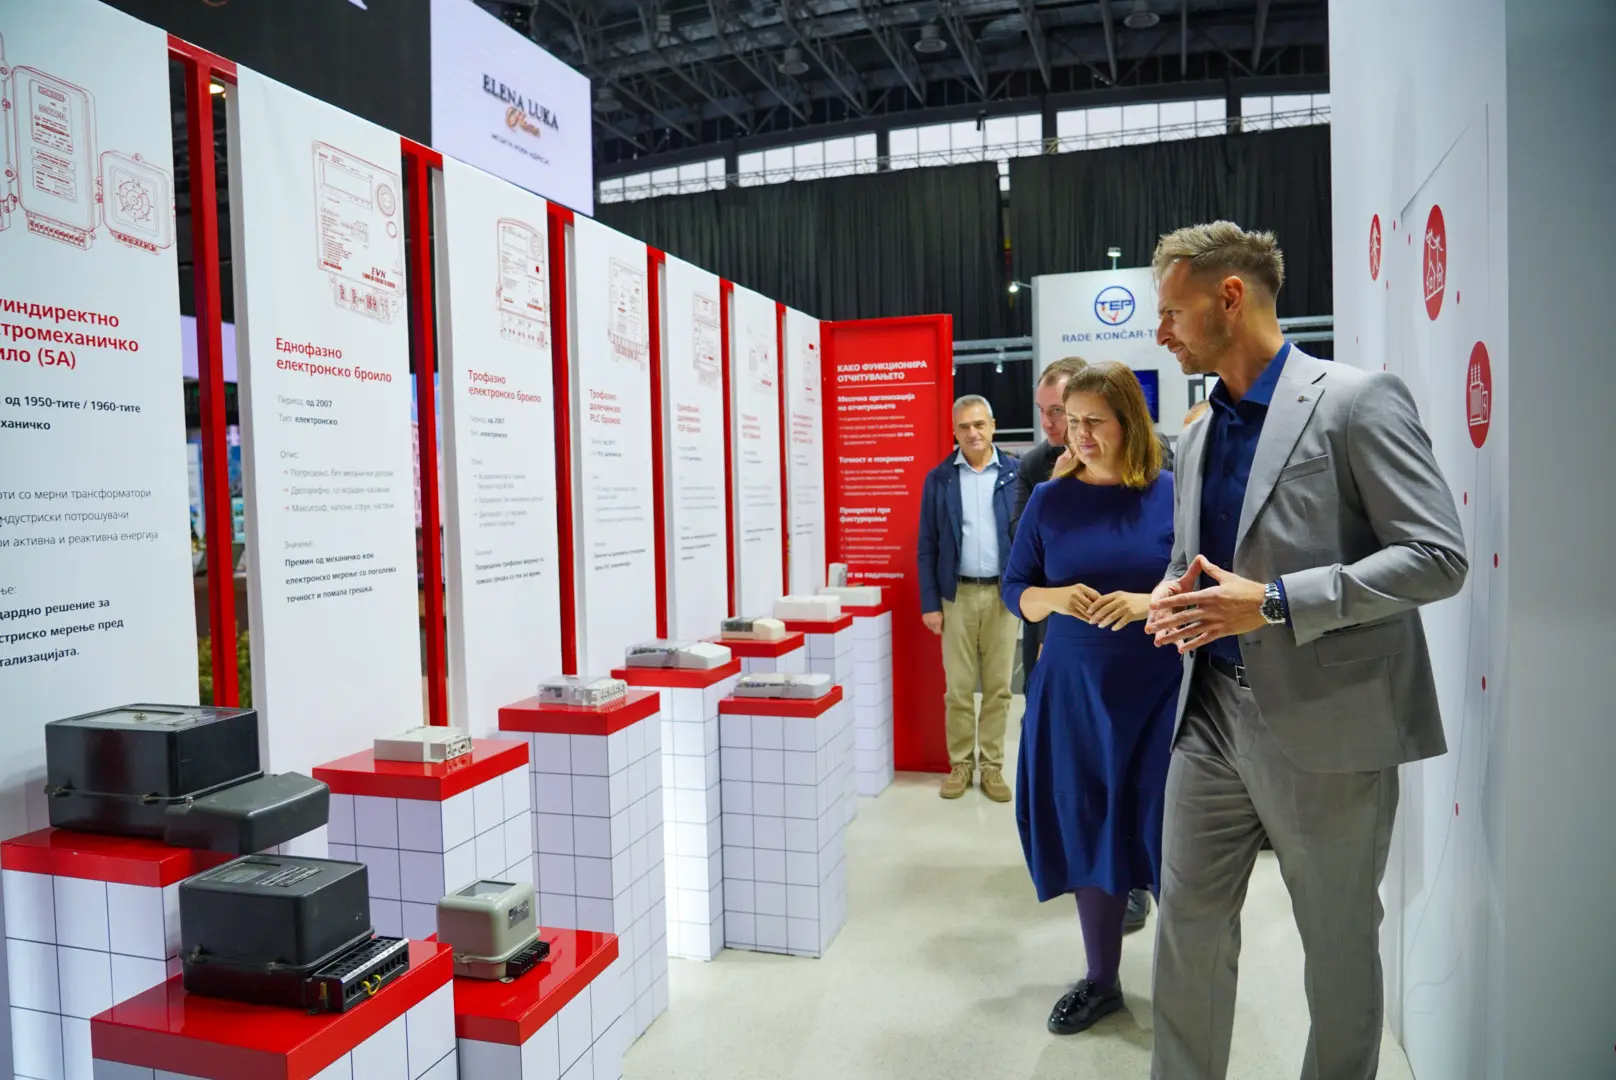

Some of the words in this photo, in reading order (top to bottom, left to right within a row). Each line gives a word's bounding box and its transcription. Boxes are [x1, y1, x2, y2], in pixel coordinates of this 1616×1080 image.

[483, 74, 524, 111] ELENA
[528, 99, 559, 130] LUKA
[371, 267, 387, 278] EVN
[1097, 300, 1133, 312] TEP
[0, 323, 139, 352] тромеханичко
[1062, 334, 1091, 343] RADE
[276, 337, 342, 359] Еднофазно
[276, 359, 351, 376] електронско
[354, 366, 392, 382] броило
[837, 364, 860, 373] КАКО
[862, 360, 927, 372] ФУНКЦИОНИРА
[468, 369, 506, 384] Трофазно
[837, 372, 905, 382] ОТЧИТУВАЊЕТО
[469, 386, 515, 400] електронско
[517, 390, 541, 403] броило
[5, 396, 21, 407] од
[25, 396, 81, 409] 1950-тите
[83, 400, 88, 410] /
[91, 401, 141, 413] 1960-тите
[306, 399, 315, 407] од
[316, 399, 332, 408] 2007
[0, 419, 51, 430] ханичко
[295, 415, 338, 426] електронско
[19, 491, 31, 500] со
[34, 489, 68, 501] мерни
[71, 488, 151, 501] трансформатори
[64, 510, 129, 524] потрошувачи
[13, 537, 56, 547] активна
[59, 535, 66, 544] и
[68, 533, 118, 546] реактивна
[121, 530, 158, 542] енергија
[285, 558, 314, 568] Премин
[315, 556, 324, 565] од
[326, 553, 361, 563] механичко
[285, 574, 331, 586] електронско
[332, 570, 358, 581] мерење
[368, 566, 397, 576] поголема
[287, 592, 315, 603] точност
[323, 589, 348, 599] помала
[45, 600, 95, 616] решение
[98, 599, 110, 608] за
[50, 623, 95, 638] мерење
[98, 618, 124, 631] пред
